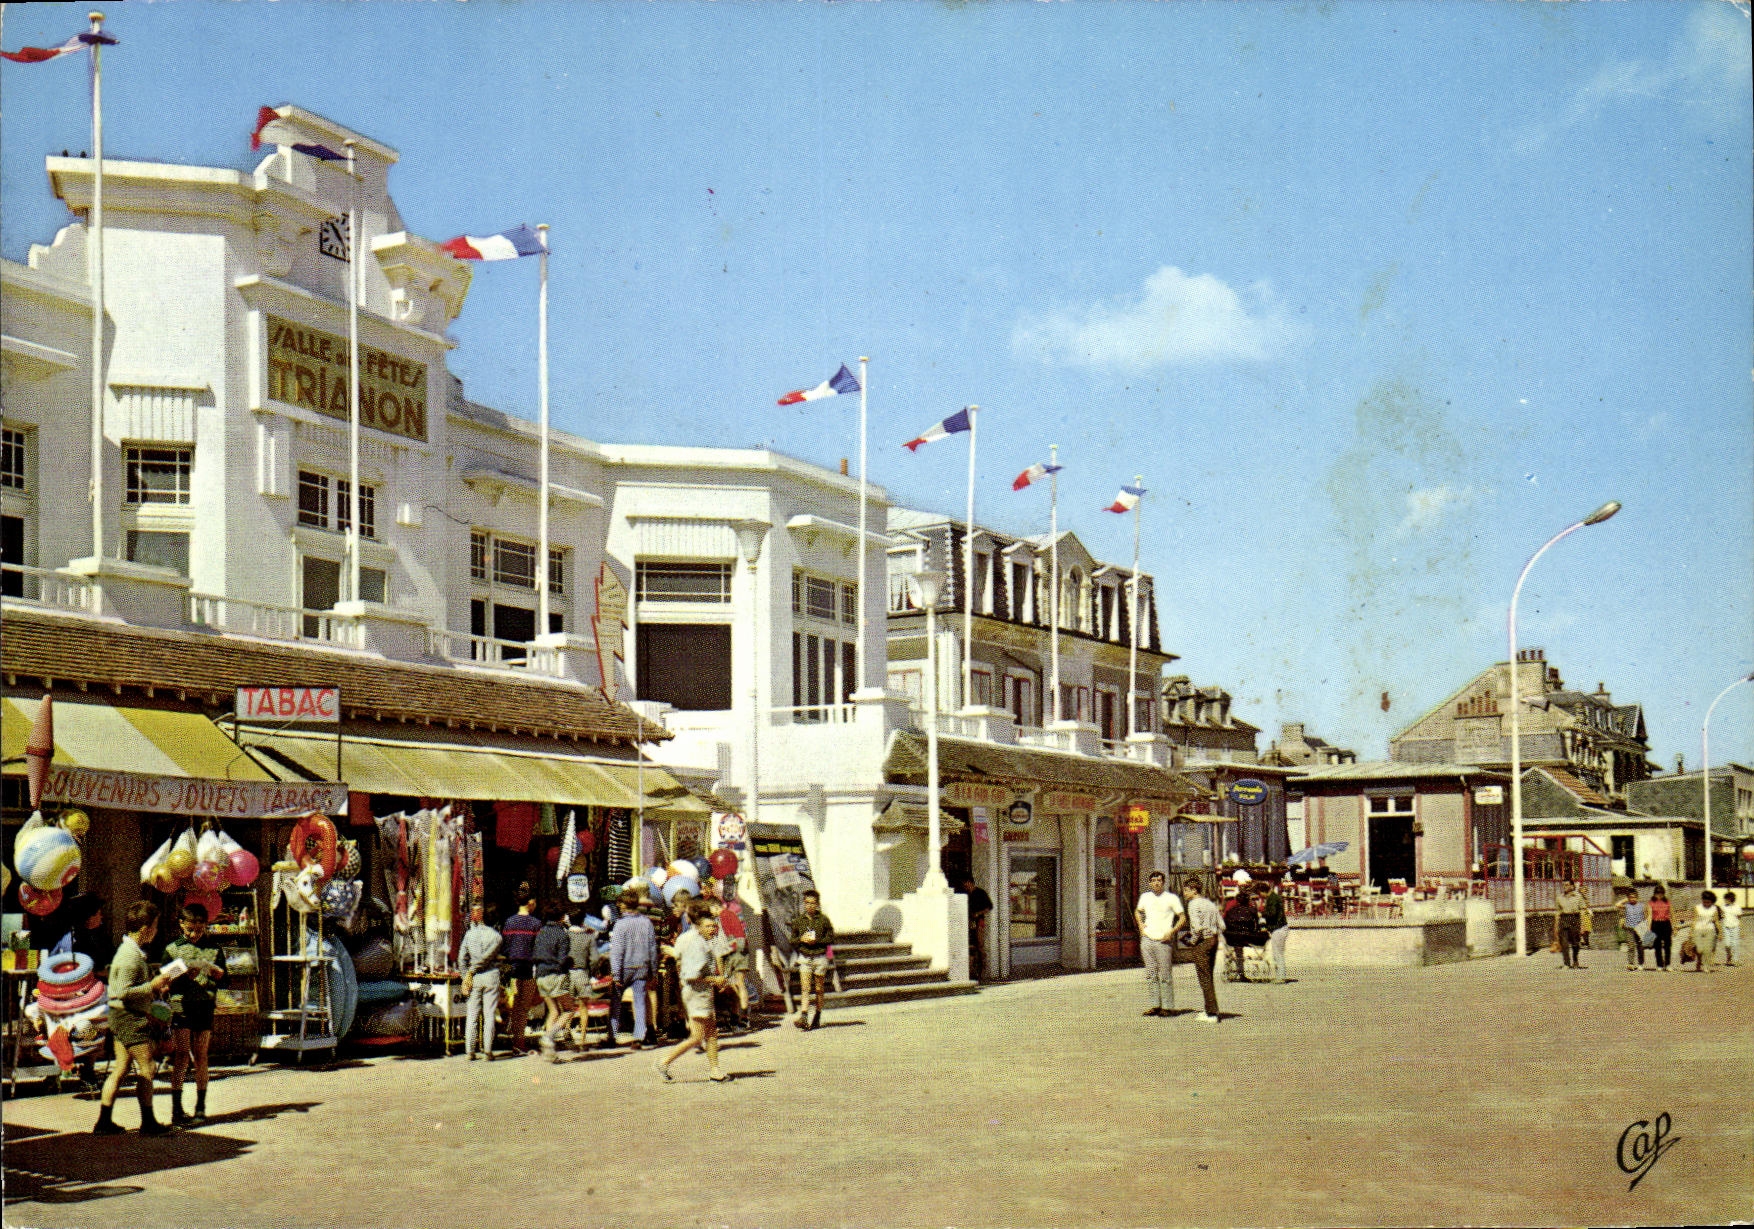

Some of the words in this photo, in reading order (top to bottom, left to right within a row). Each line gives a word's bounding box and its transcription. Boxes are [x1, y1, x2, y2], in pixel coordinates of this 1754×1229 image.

[272, 324, 332, 363] SALLE
[270, 358, 424, 436] TRIANON
[243, 688, 334, 717] TABAC
[42, 768, 162, 808] SOUVENIRS
[171, 783, 248, 814] JOUETS
